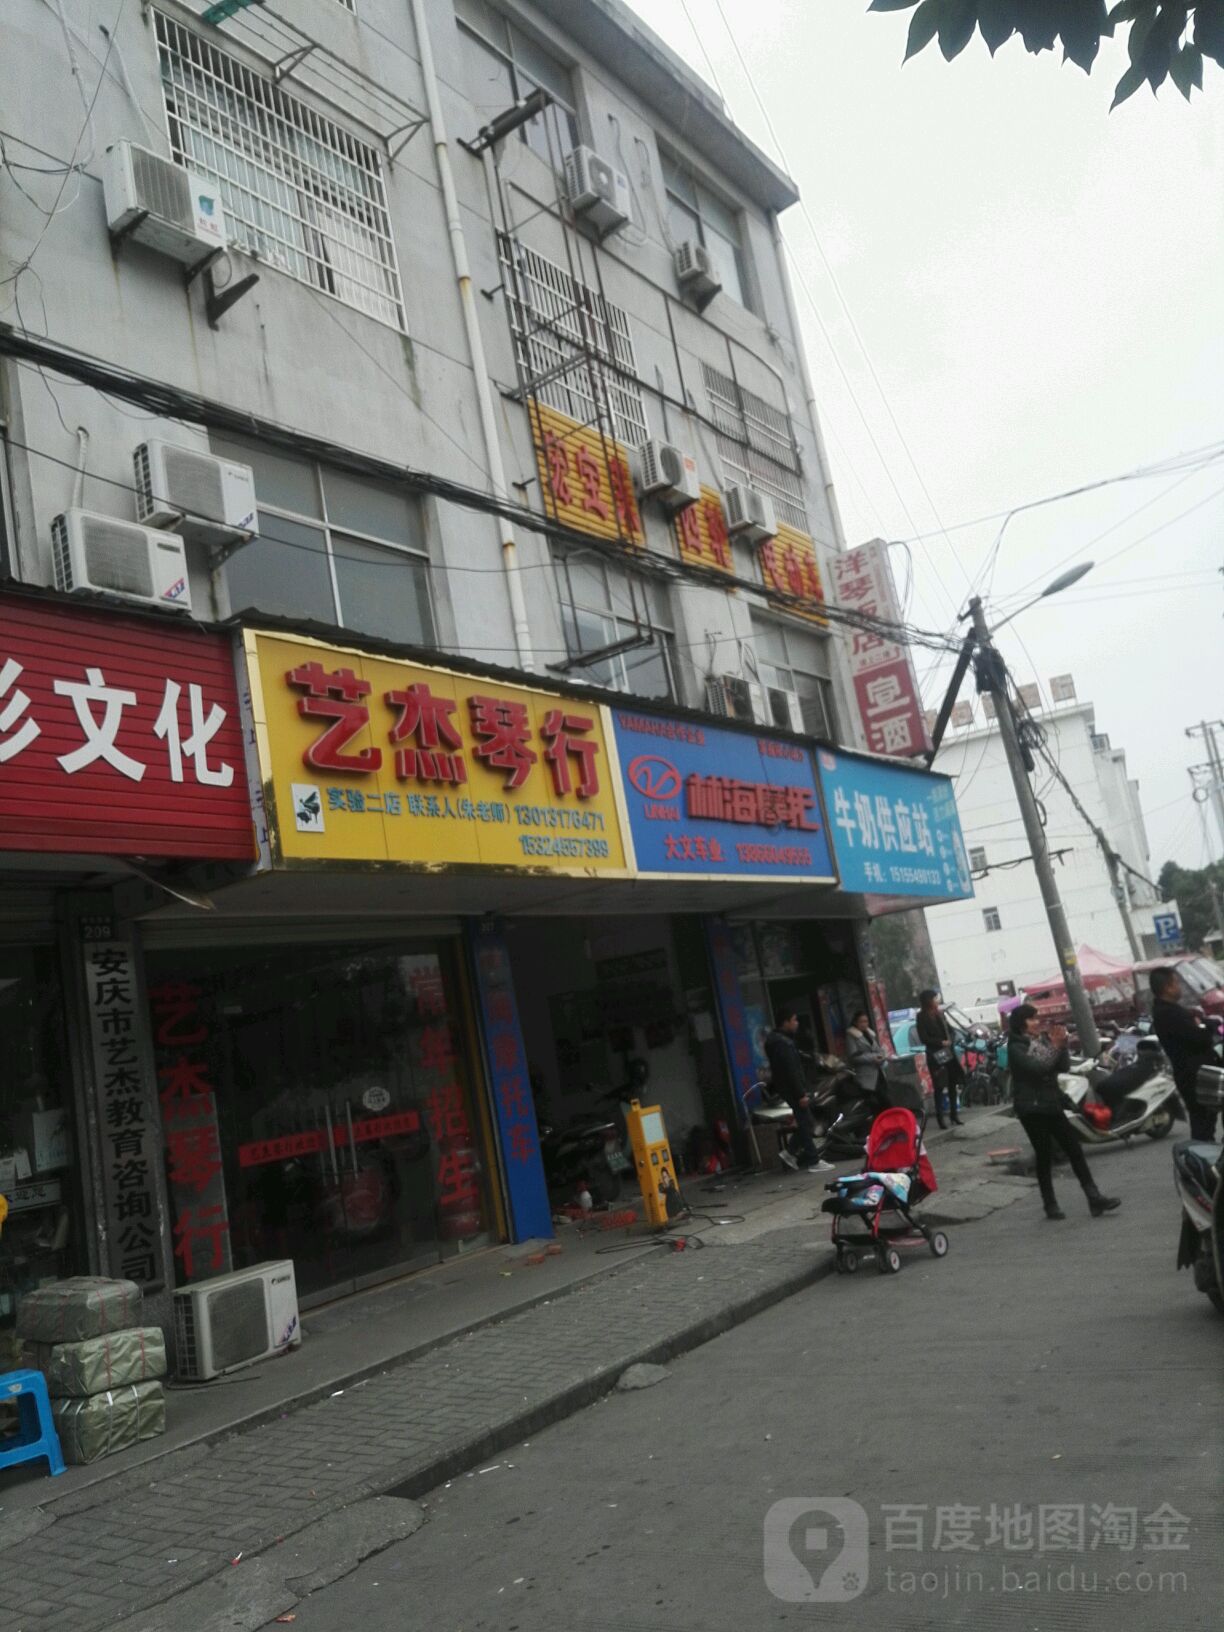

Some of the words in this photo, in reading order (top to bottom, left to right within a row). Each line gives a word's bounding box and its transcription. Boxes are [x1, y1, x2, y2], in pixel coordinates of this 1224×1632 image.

[0, 658, 234, 787] 文化
[286, 661, 601, 800] 艺杰琴行
[326, 787, 402, 816] 实验二店
[514, 804, 606, 831] 13013176471
[686, 772, 820, 832] 林海摩托
[834, 786, 935, 857] 牛奶供应站
[84, 925, 112, 938] 209
[1156, 917, 1175, 938] P
[92, 948, 155, 1281] 安庆市艺杰教育咨询公司
[148, 982, 229, 1278] 艺杰琴行
[409, 965, 481, 1207] 常年招生
